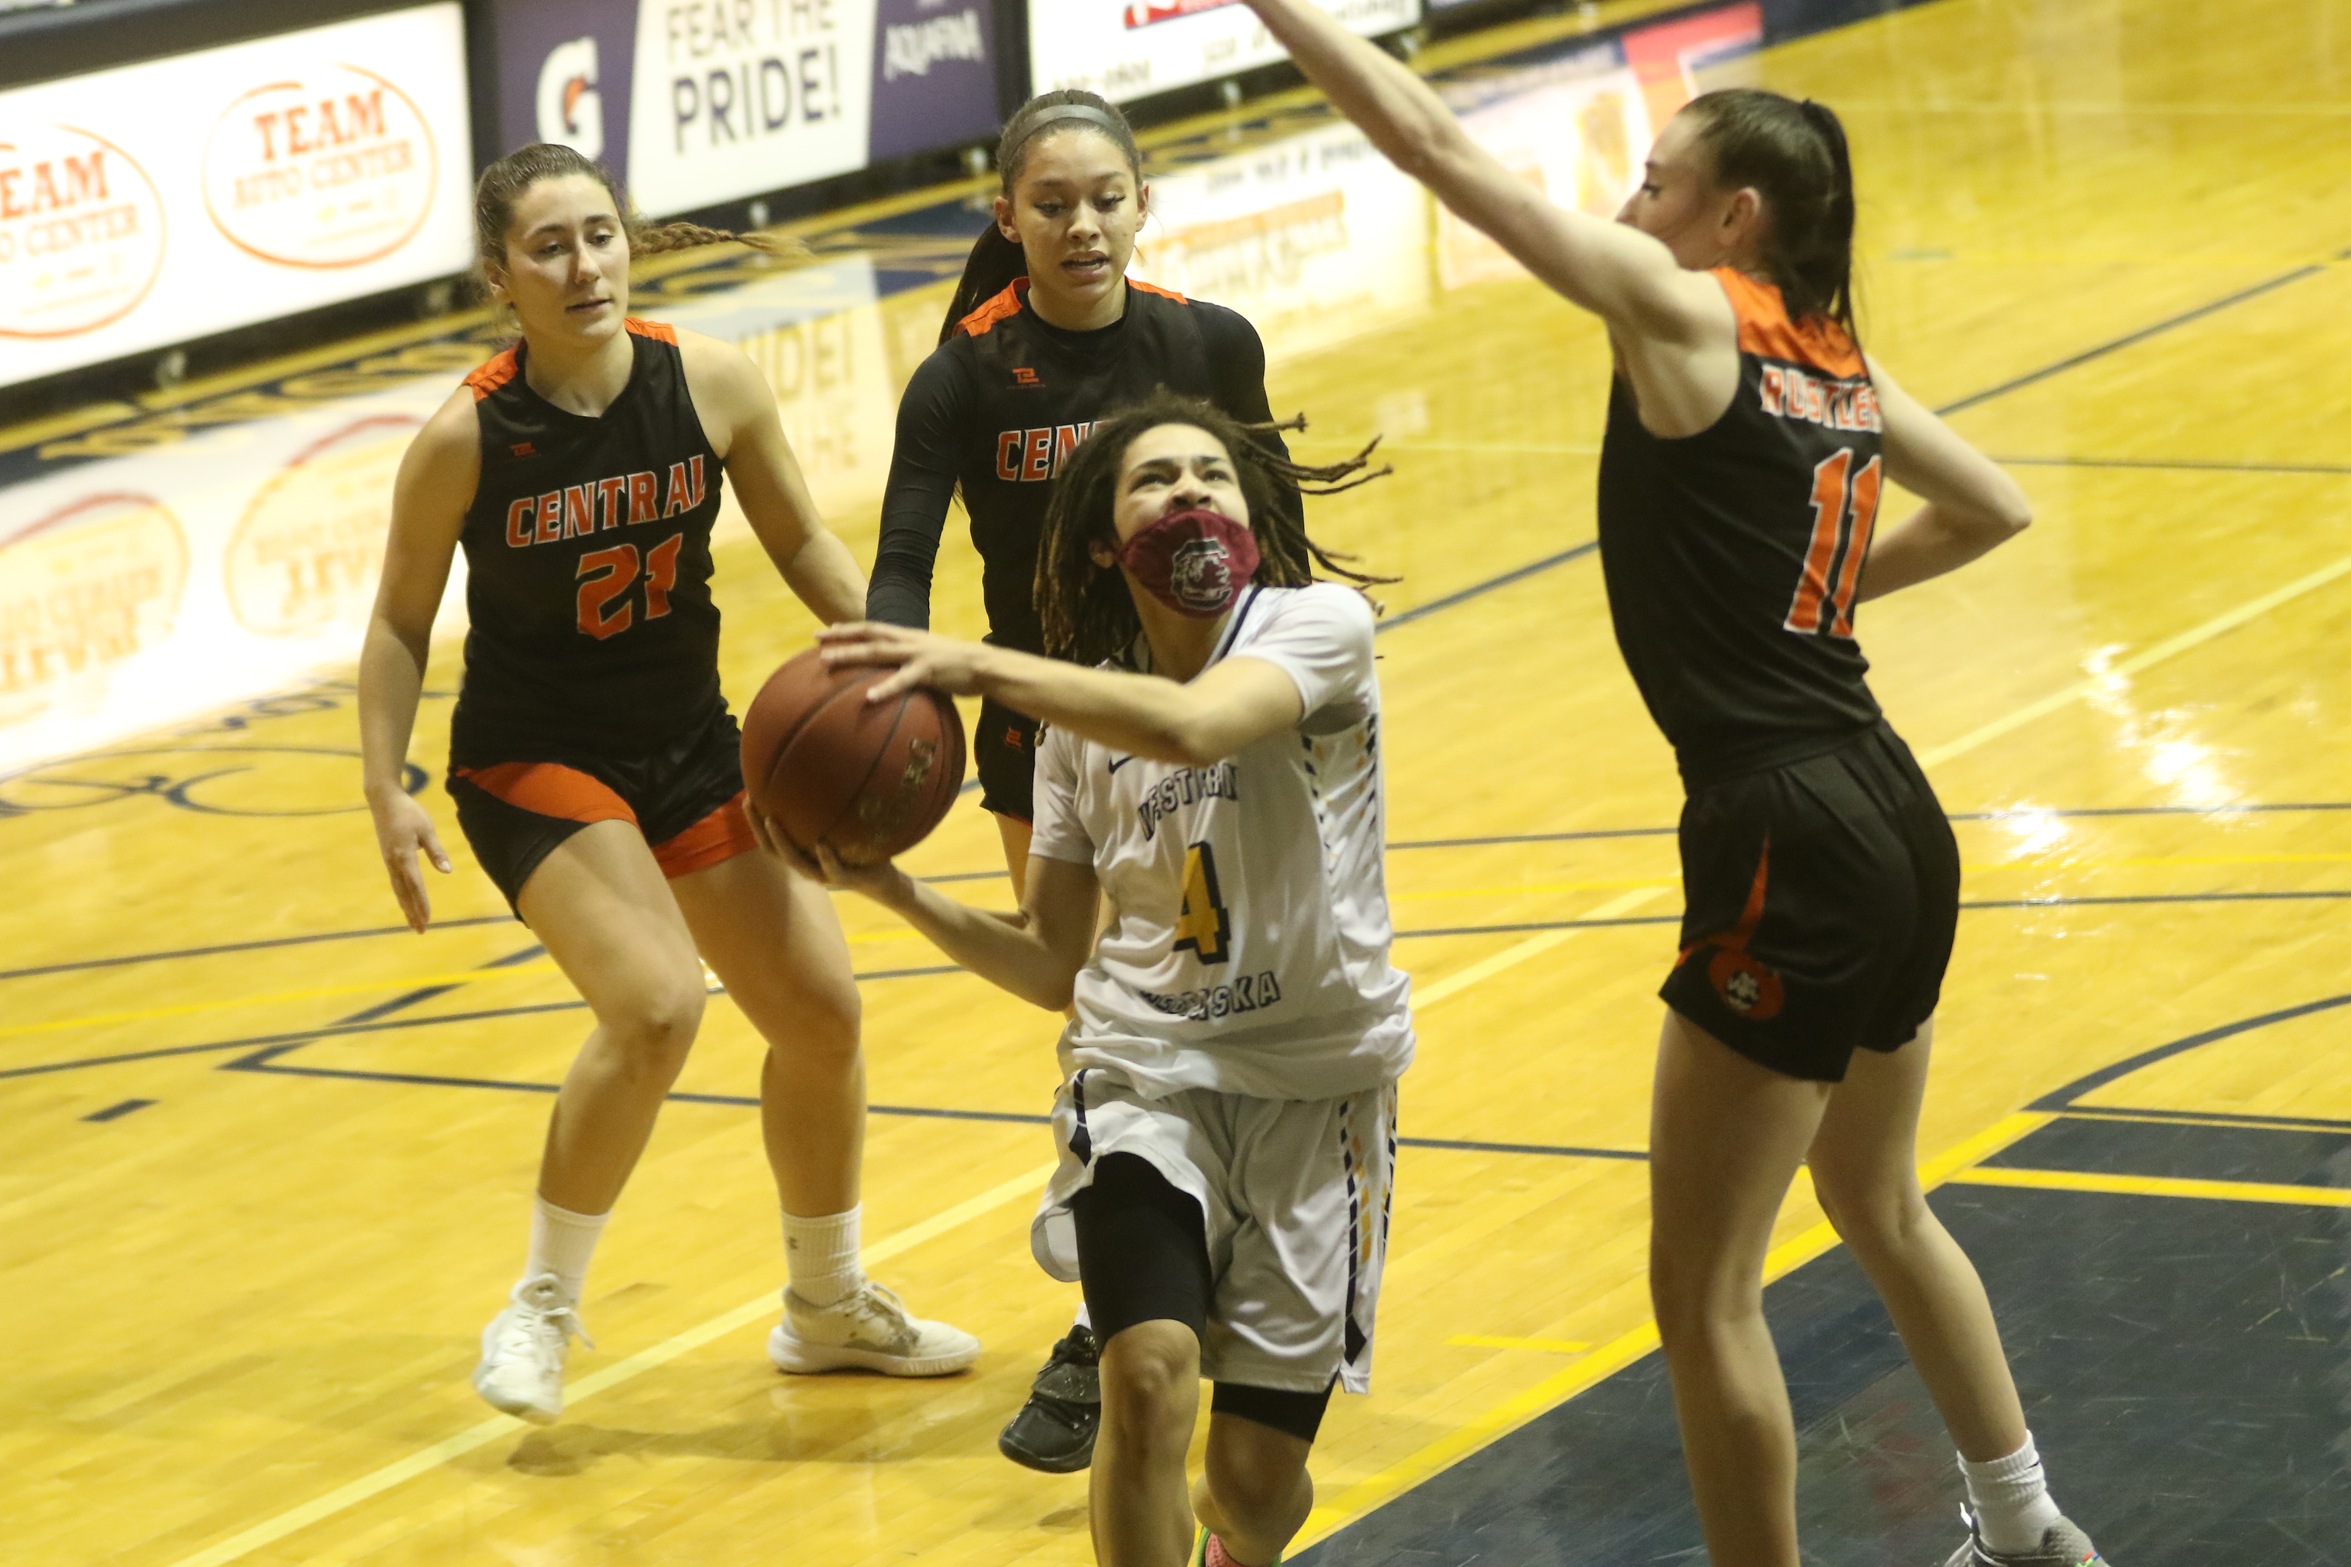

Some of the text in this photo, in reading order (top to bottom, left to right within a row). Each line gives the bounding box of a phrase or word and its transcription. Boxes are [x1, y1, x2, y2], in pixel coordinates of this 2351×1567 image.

[667, 0, 755, 63] FEAR
[253, 89, 387, 163] TEAM
[672, 44, 841, 155] PRIDE!
[0, 150, 109, 221] EAM
[506, 453, 707, 548] CENTRAL
[1783, 447, 1882, 640] 11
[575, 533, 682, 641] 21
[1173, 840, 1231, 965] 4
